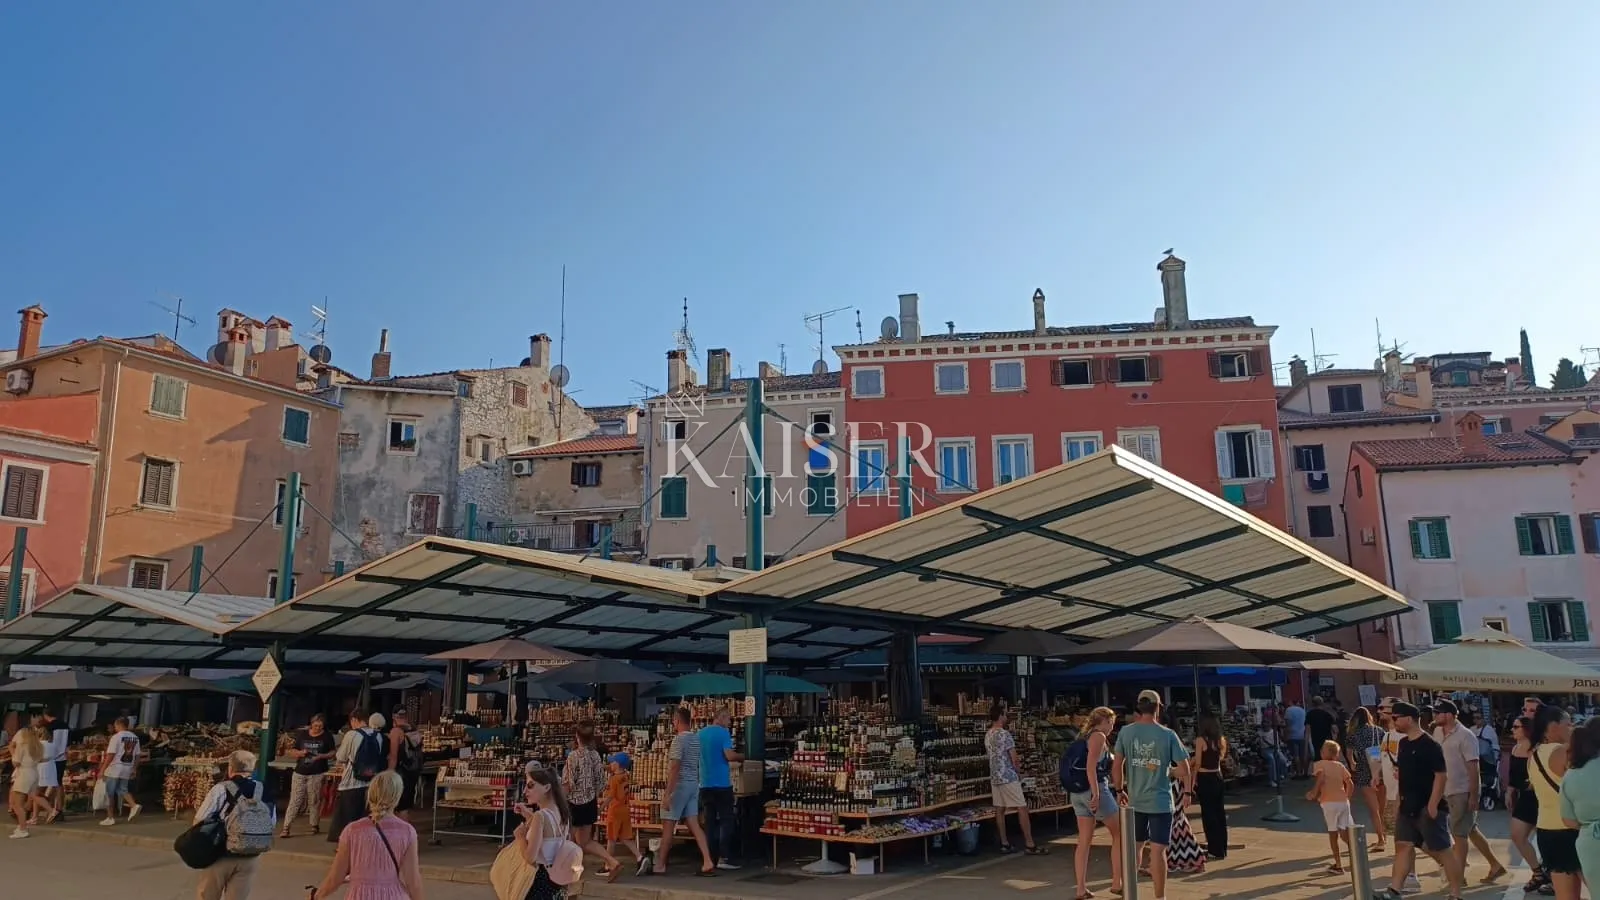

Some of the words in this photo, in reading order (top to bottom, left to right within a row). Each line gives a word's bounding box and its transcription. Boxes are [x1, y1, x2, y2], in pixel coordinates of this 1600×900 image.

[1394, 671, 1418, 681] Jana
[1442, 675, 1479, 684] NATURAL
[1480, 676, 1515, 685] MINERAL
[1517, 678, 1545, 686] WATER
[1572, 678, 1600, 688] Jana
